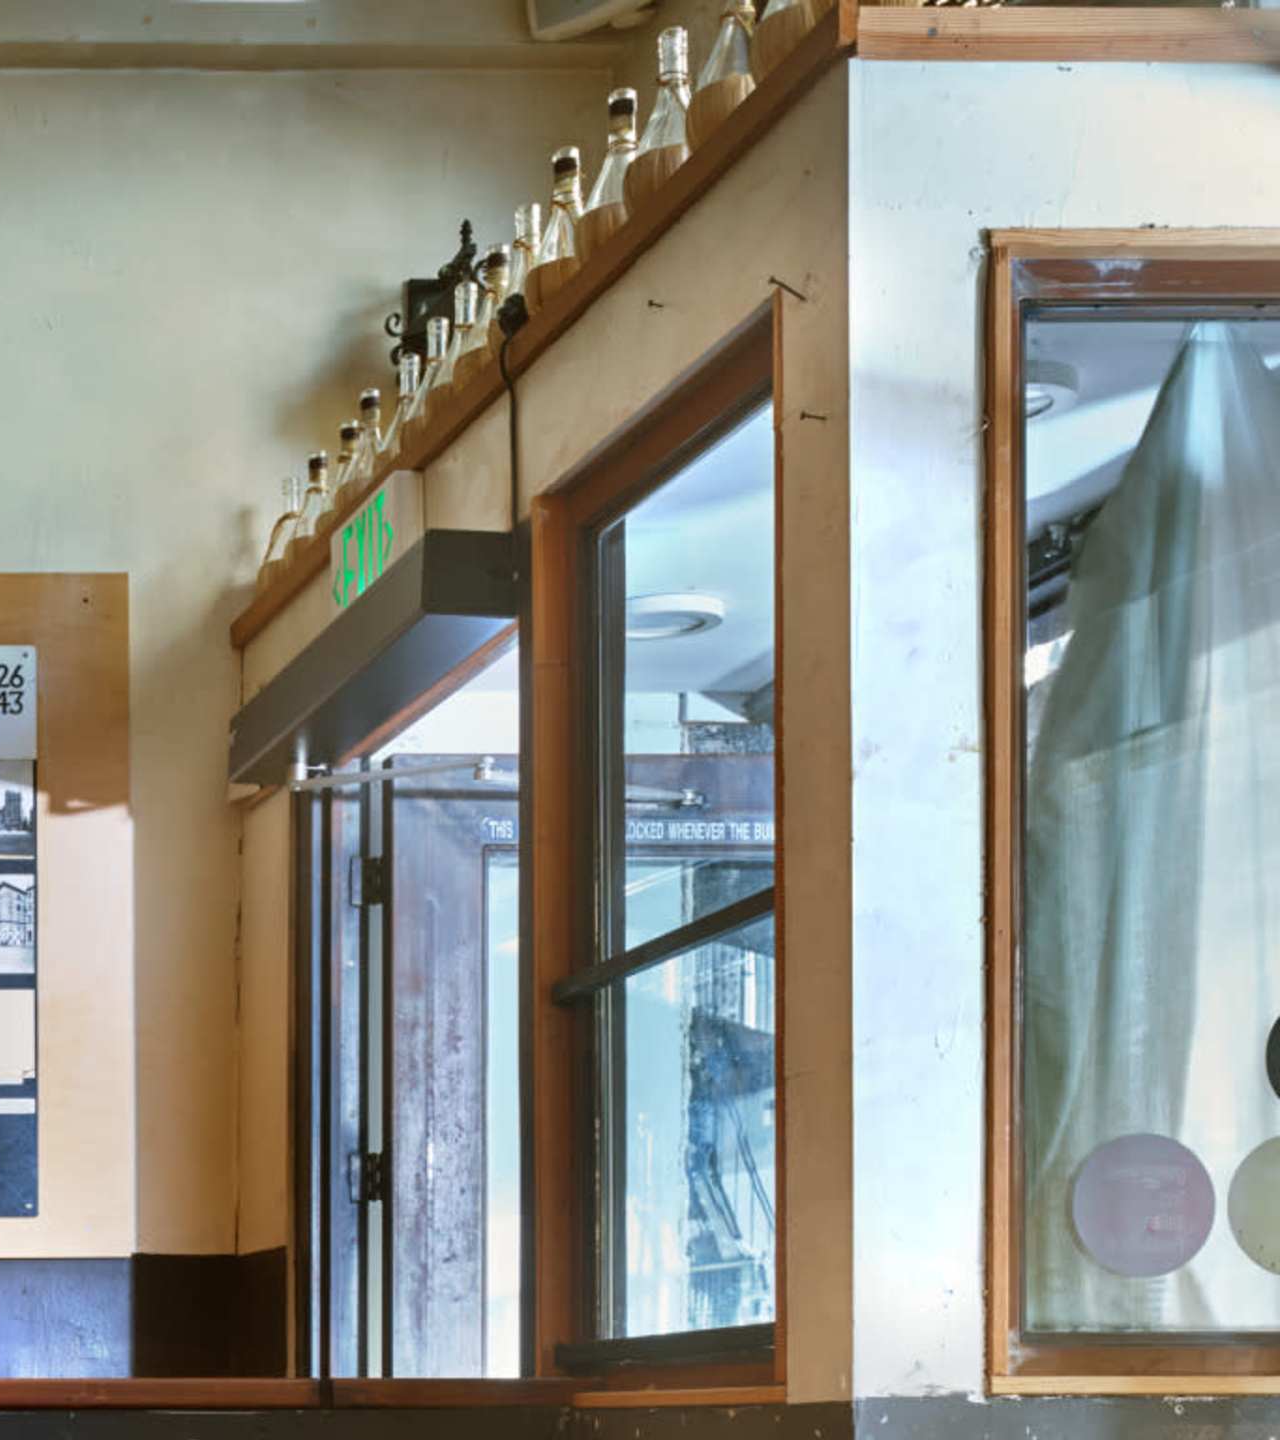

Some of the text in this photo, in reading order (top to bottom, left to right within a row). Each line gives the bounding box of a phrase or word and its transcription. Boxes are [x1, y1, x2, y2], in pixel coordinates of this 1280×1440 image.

[342, 489, 386, 609] EXIT
[625, 821, 664, 840] OCKED
[668, 821, 726, 840] WHENEVER
[729, 822, 751, 840] THE
